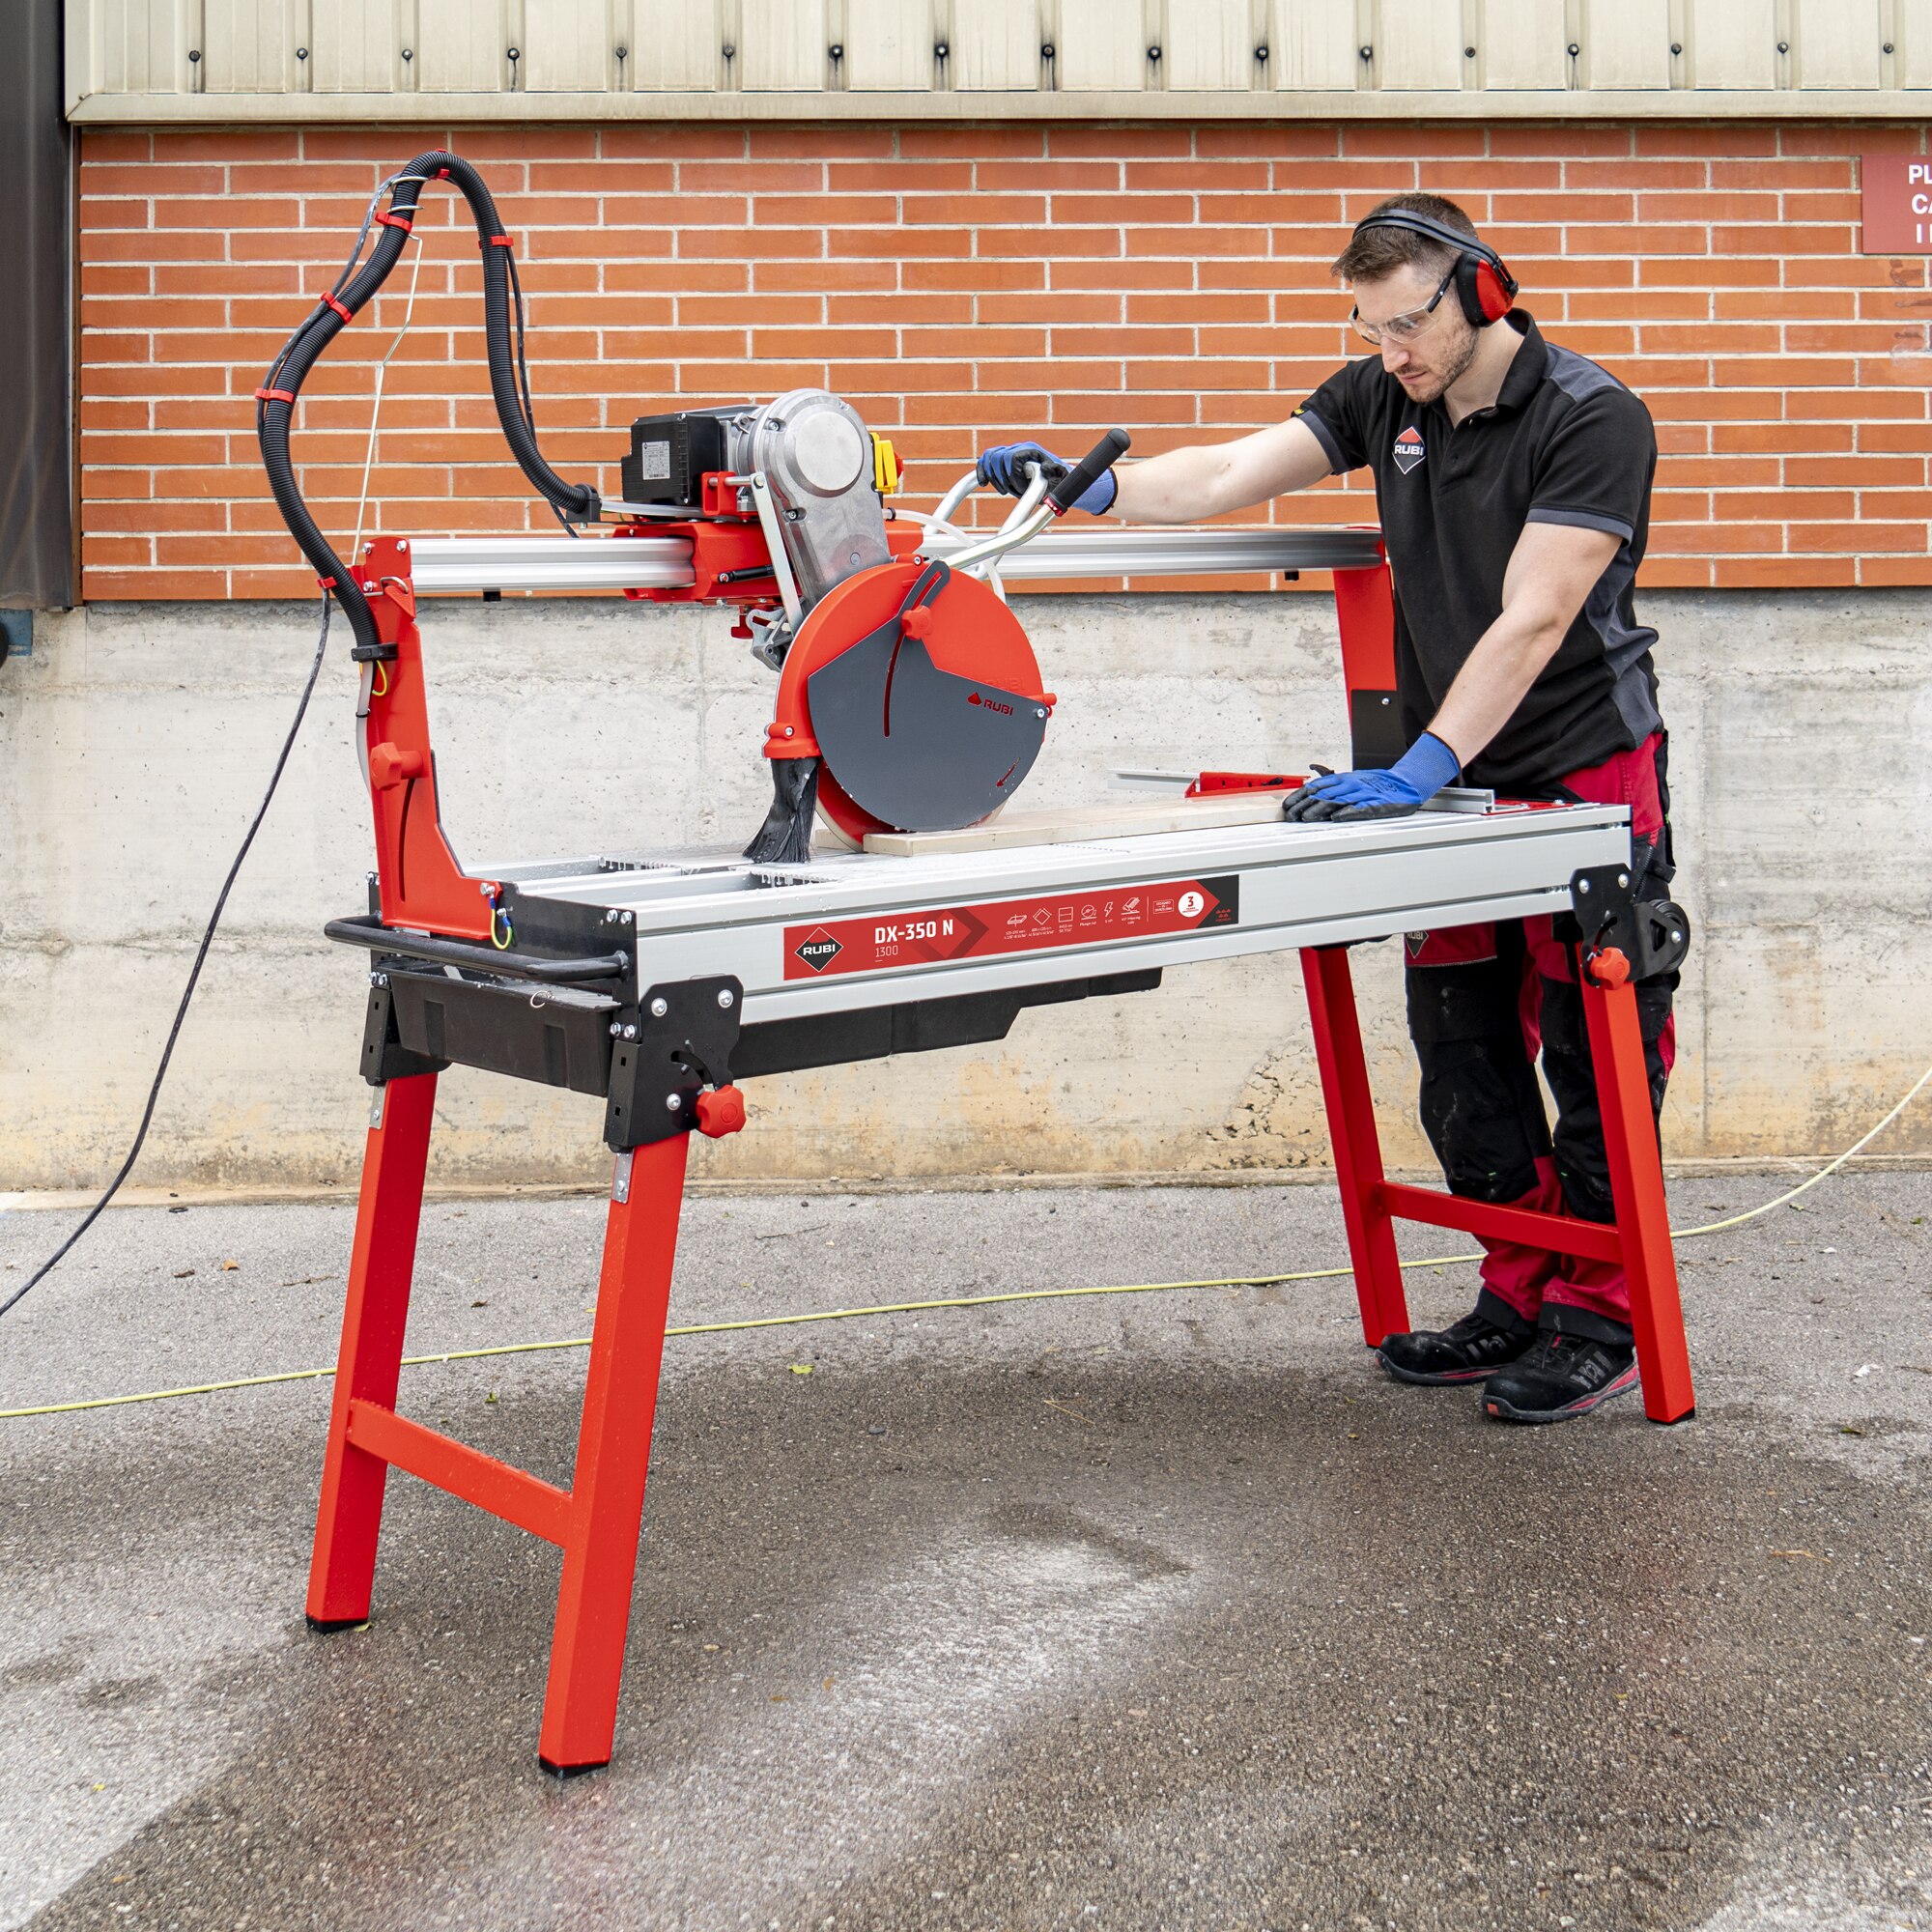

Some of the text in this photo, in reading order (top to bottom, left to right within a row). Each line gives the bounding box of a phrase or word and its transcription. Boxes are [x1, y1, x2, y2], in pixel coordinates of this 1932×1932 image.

[1911, 193, 1932, 214] C
[1394, 444, 1424, 456] RUBI
[983, 698, 1013, 715] RUBI
[1187, 895, 1194, 907] 3
[874, 919, 953, 945] DX-350 N
[803, 943, 837, 956] RUBI
[875, 945, 899, 958] 1300
